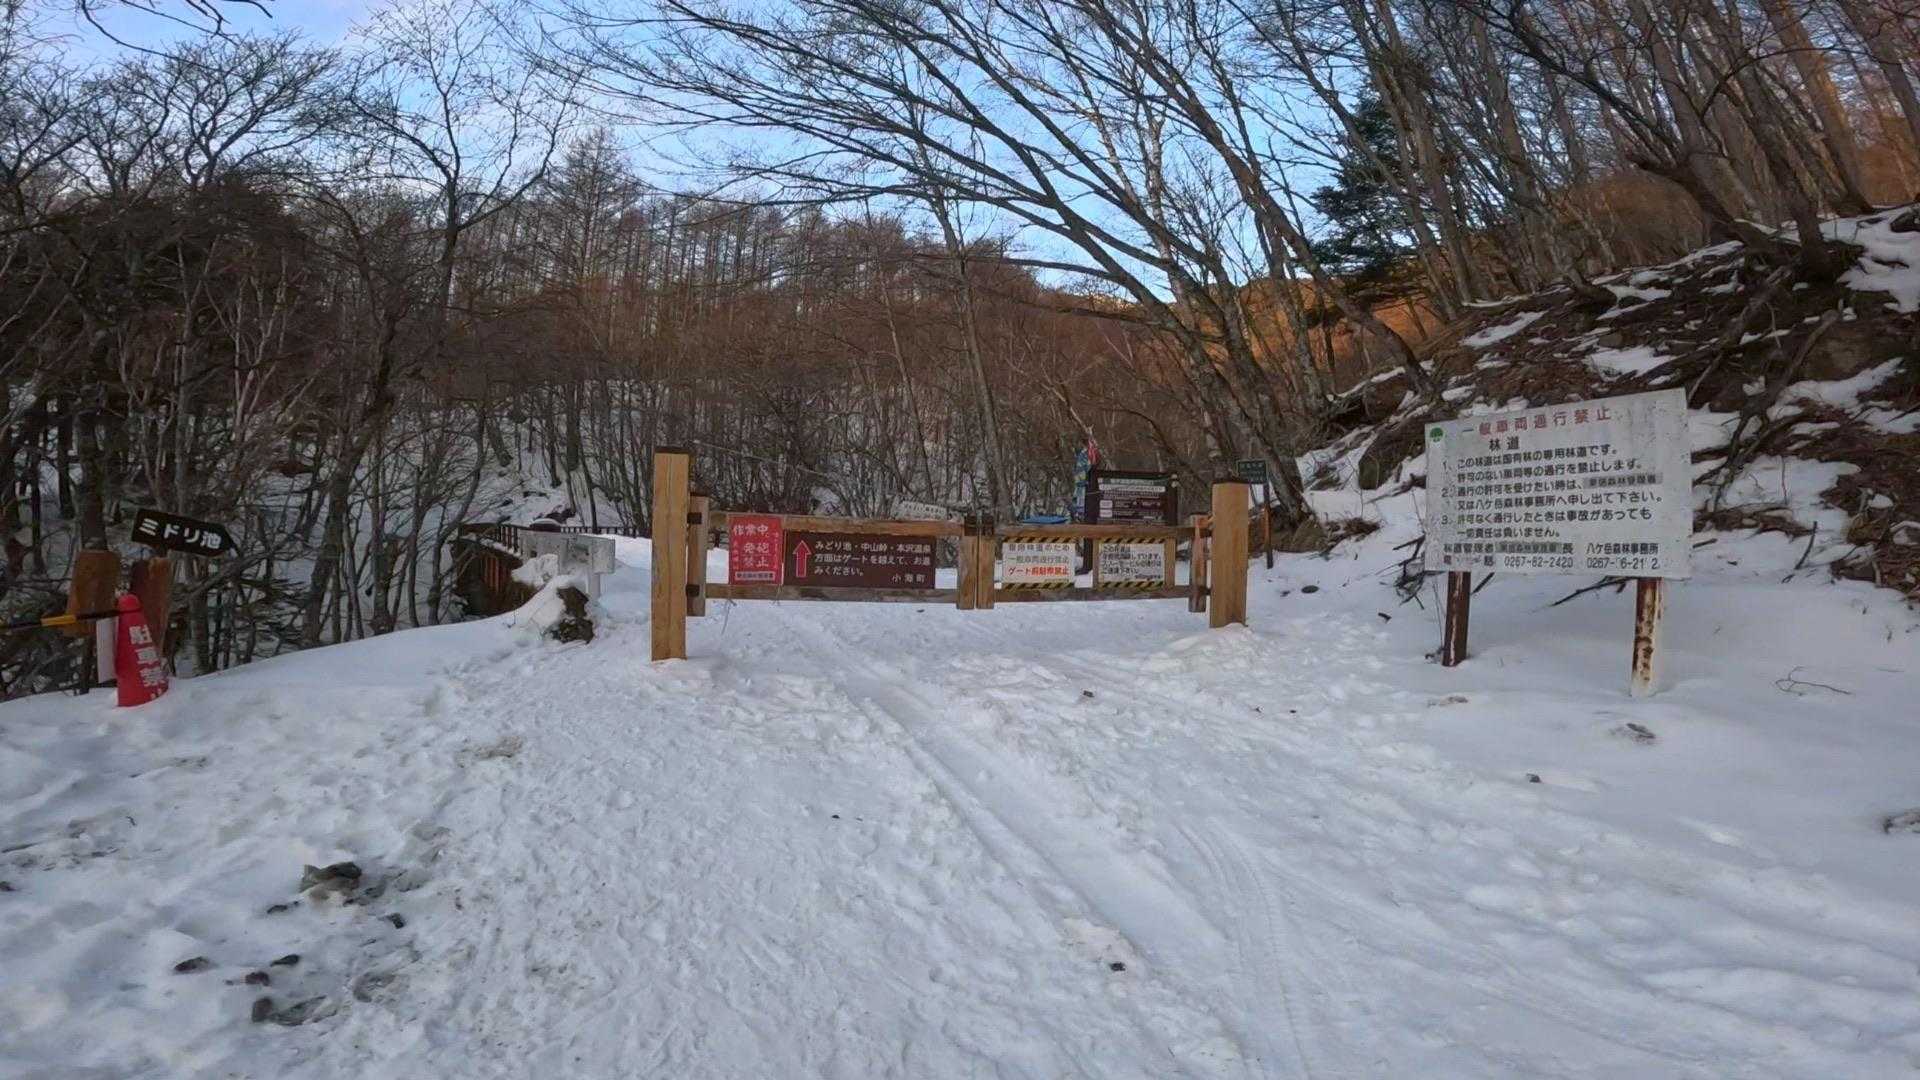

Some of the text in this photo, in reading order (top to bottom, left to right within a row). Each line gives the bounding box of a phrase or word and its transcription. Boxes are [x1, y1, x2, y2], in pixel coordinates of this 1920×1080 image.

[1462, 408, 1611, 437] 一般車両通行禁止
[1489, 436, 1520, 451] 林道
[138, 518, 222, 549] ミドリ池
